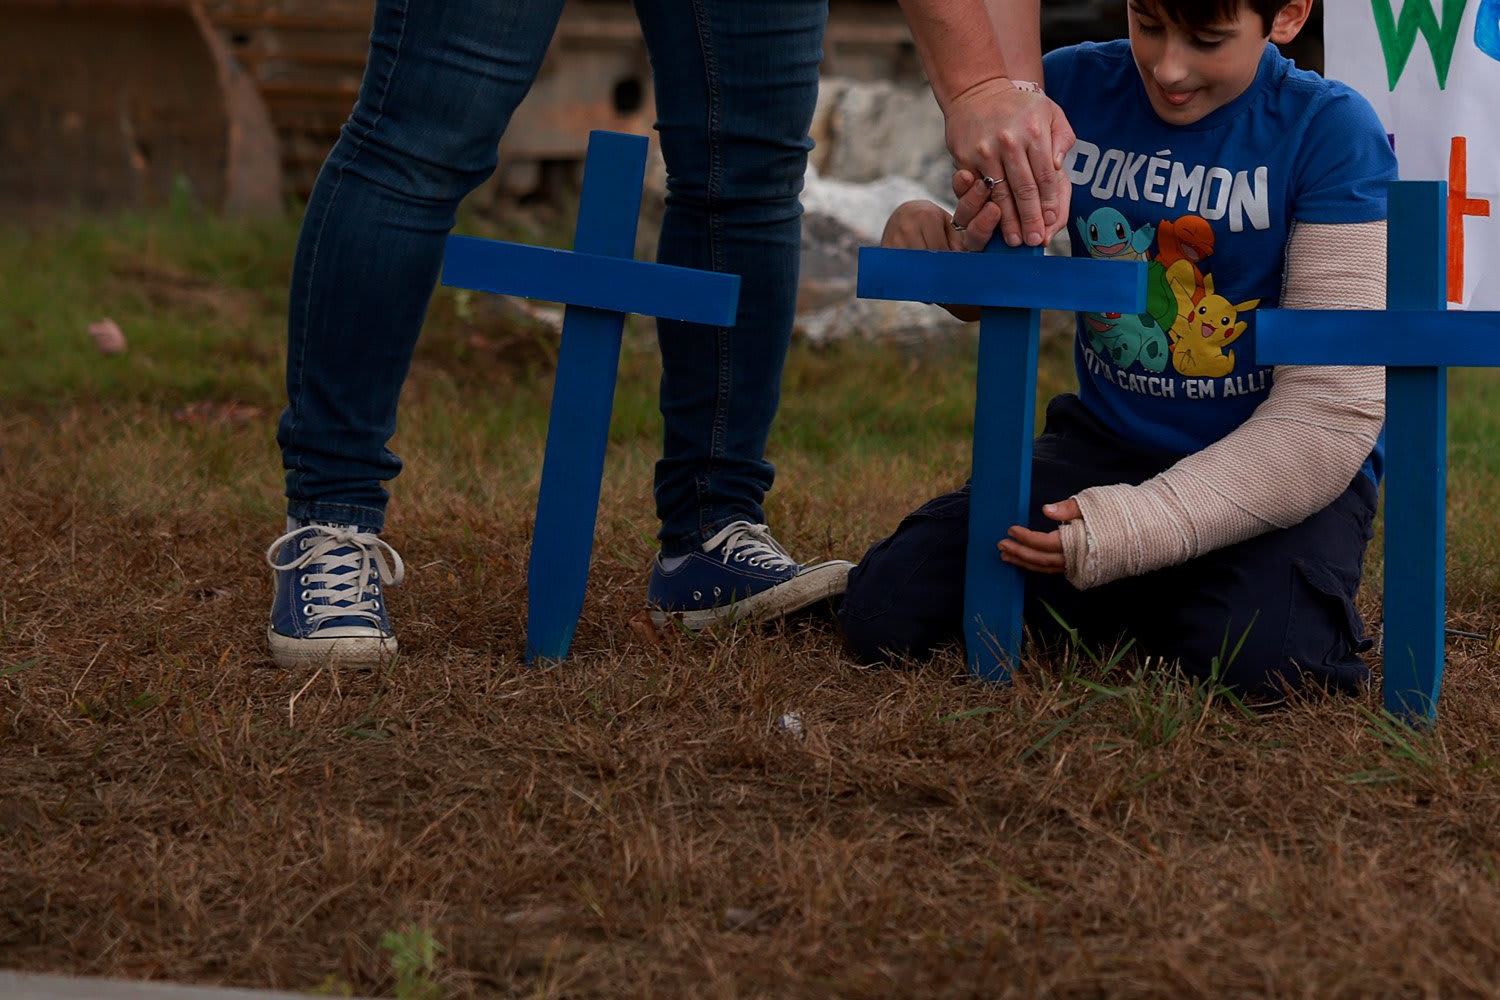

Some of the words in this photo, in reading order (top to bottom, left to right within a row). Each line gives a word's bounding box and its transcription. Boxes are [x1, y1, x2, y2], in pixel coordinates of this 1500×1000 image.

[1064, 138, 1271, 233] POKÉMON
[1118, 368, 1176, 399] CATCH
[1181, 378, 1216, 400] 'EM
